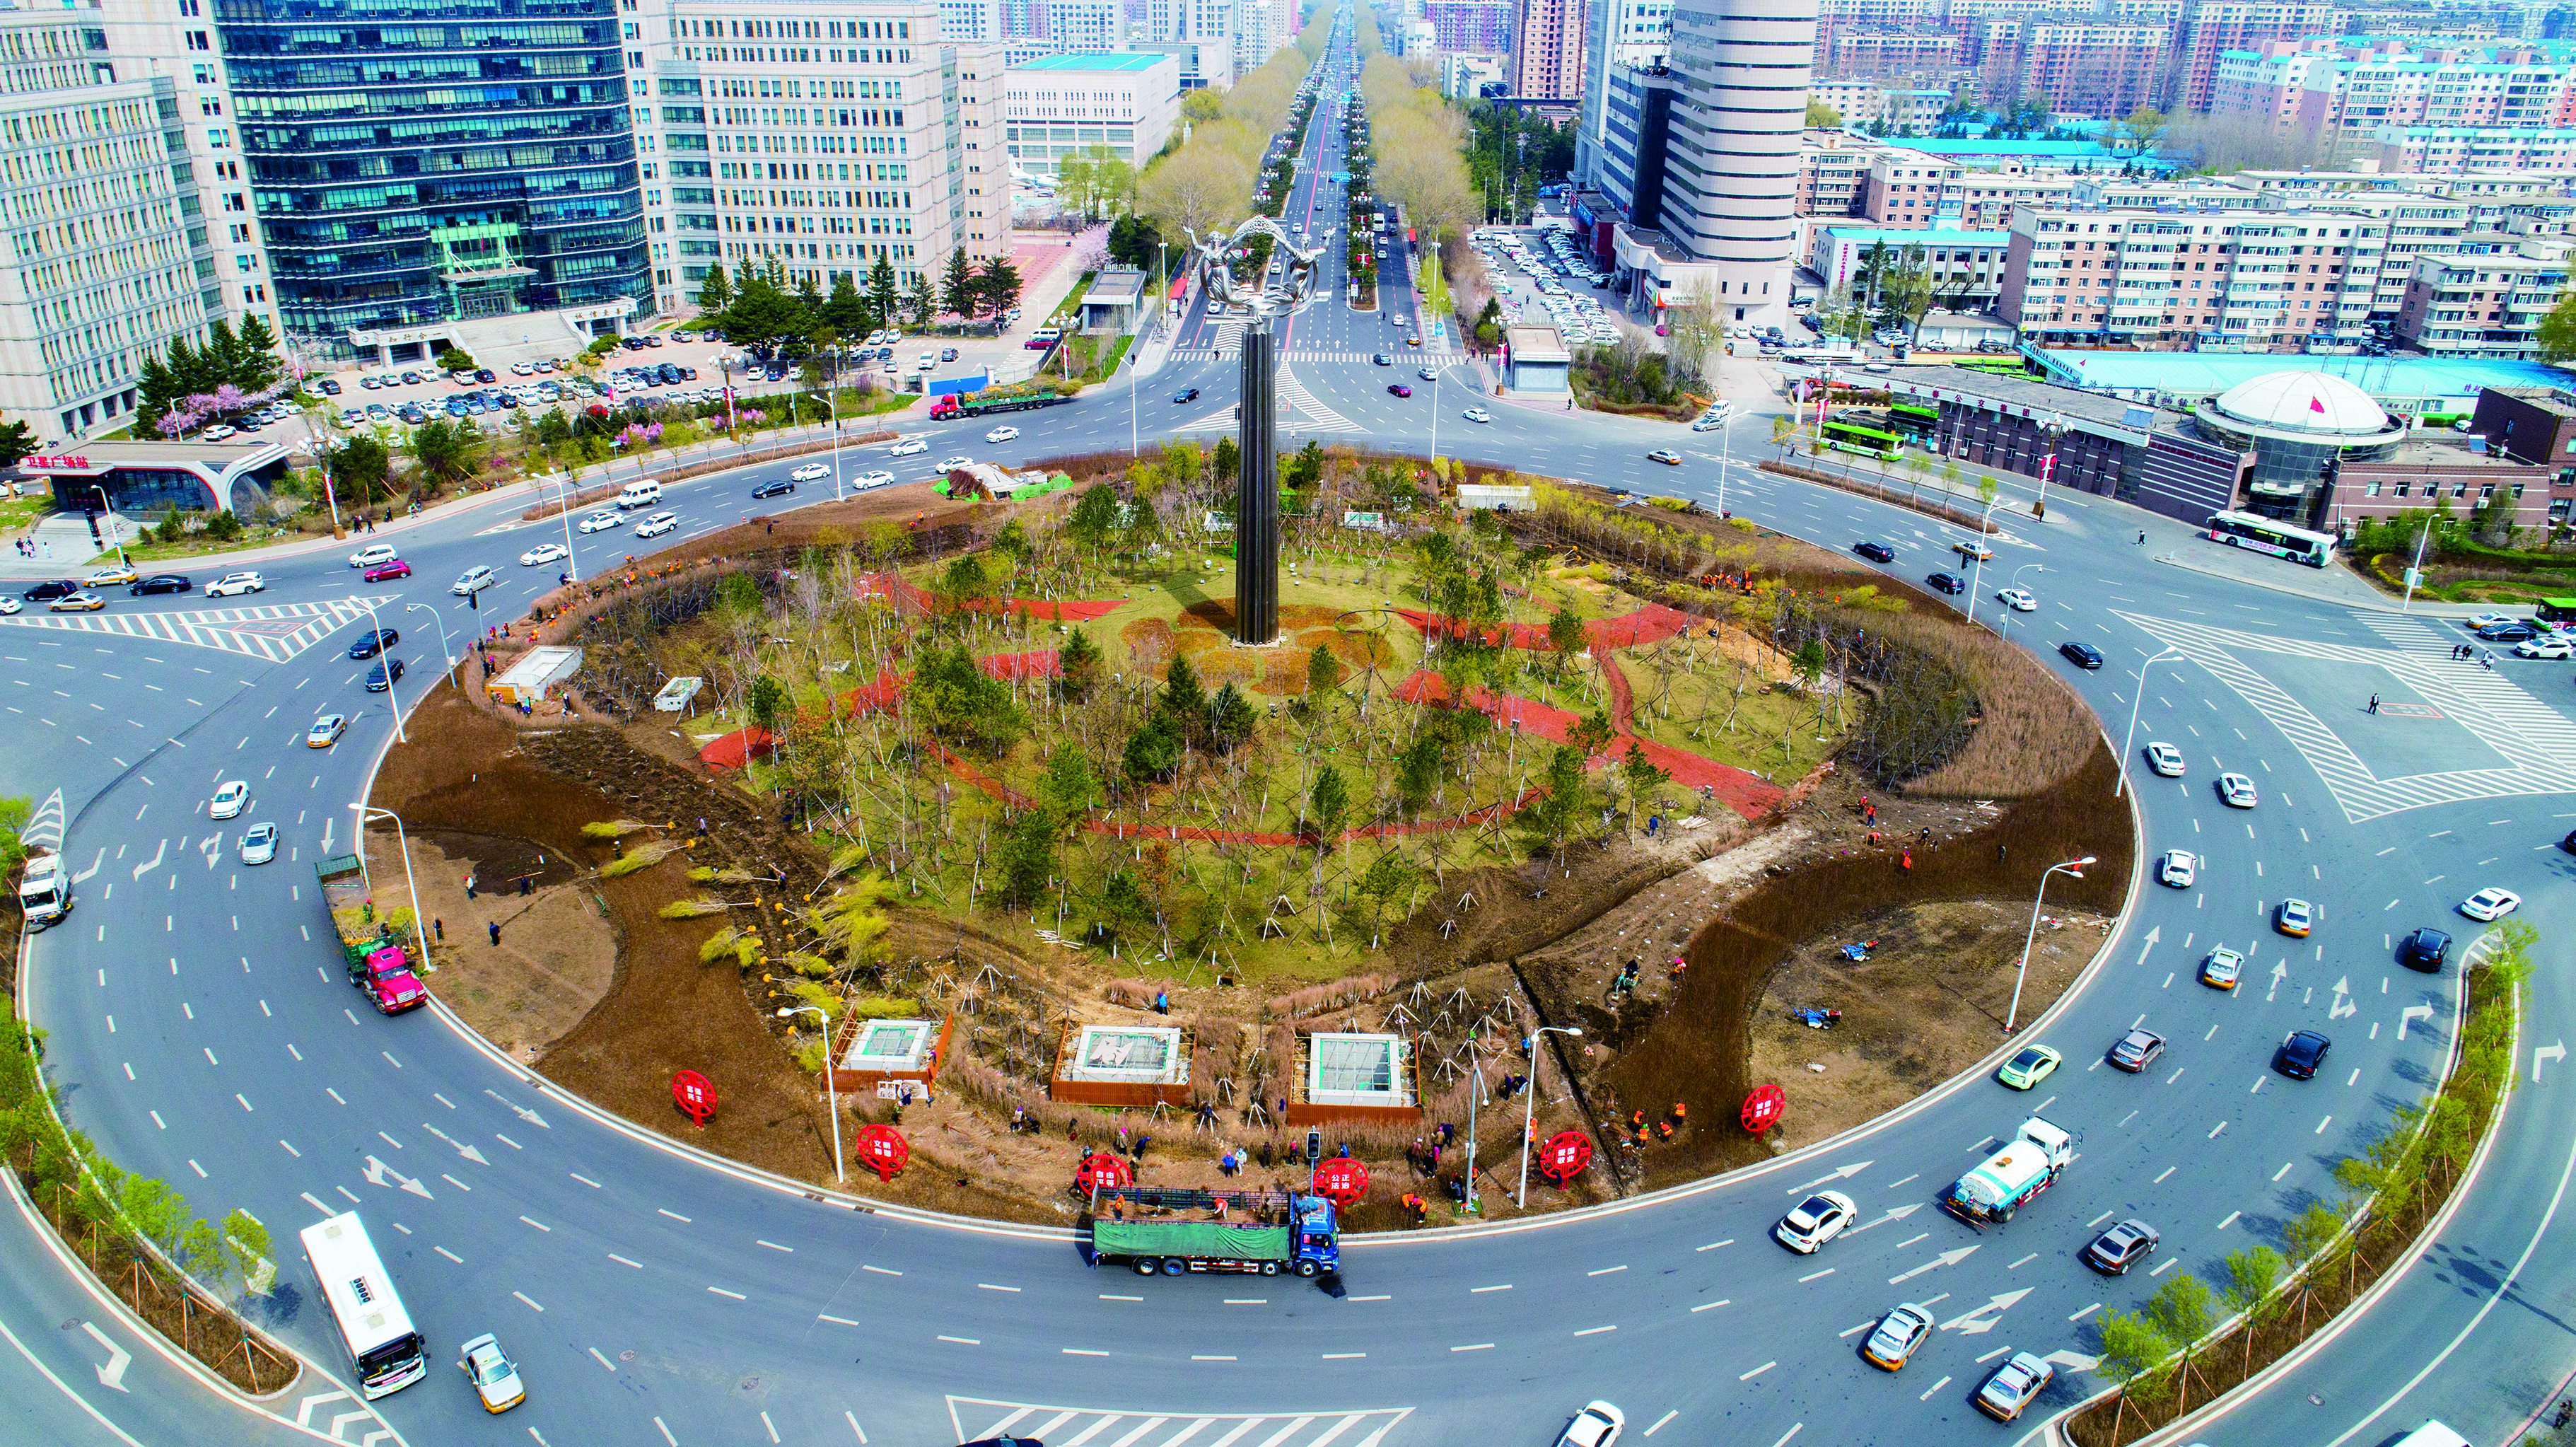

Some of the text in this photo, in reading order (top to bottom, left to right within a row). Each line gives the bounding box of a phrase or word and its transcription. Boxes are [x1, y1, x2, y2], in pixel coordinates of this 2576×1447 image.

[1910, 385, 2030, 417] 长春公交集团
[25, 455, 89, 468] 卫星广场站
[687, 1093, 704, 1103] 民主
[1756, 1100, 1772, 1110] 诚信
[873, 1140, 891, 1150] 文明
[874, 1147, 892, 1158] 和谐
[1558, 1146, 1575, 1157] 爱国
[1557, 1155, 1575, 1165] 敬业
[1096, 1170, 1114, 1179] 自由
